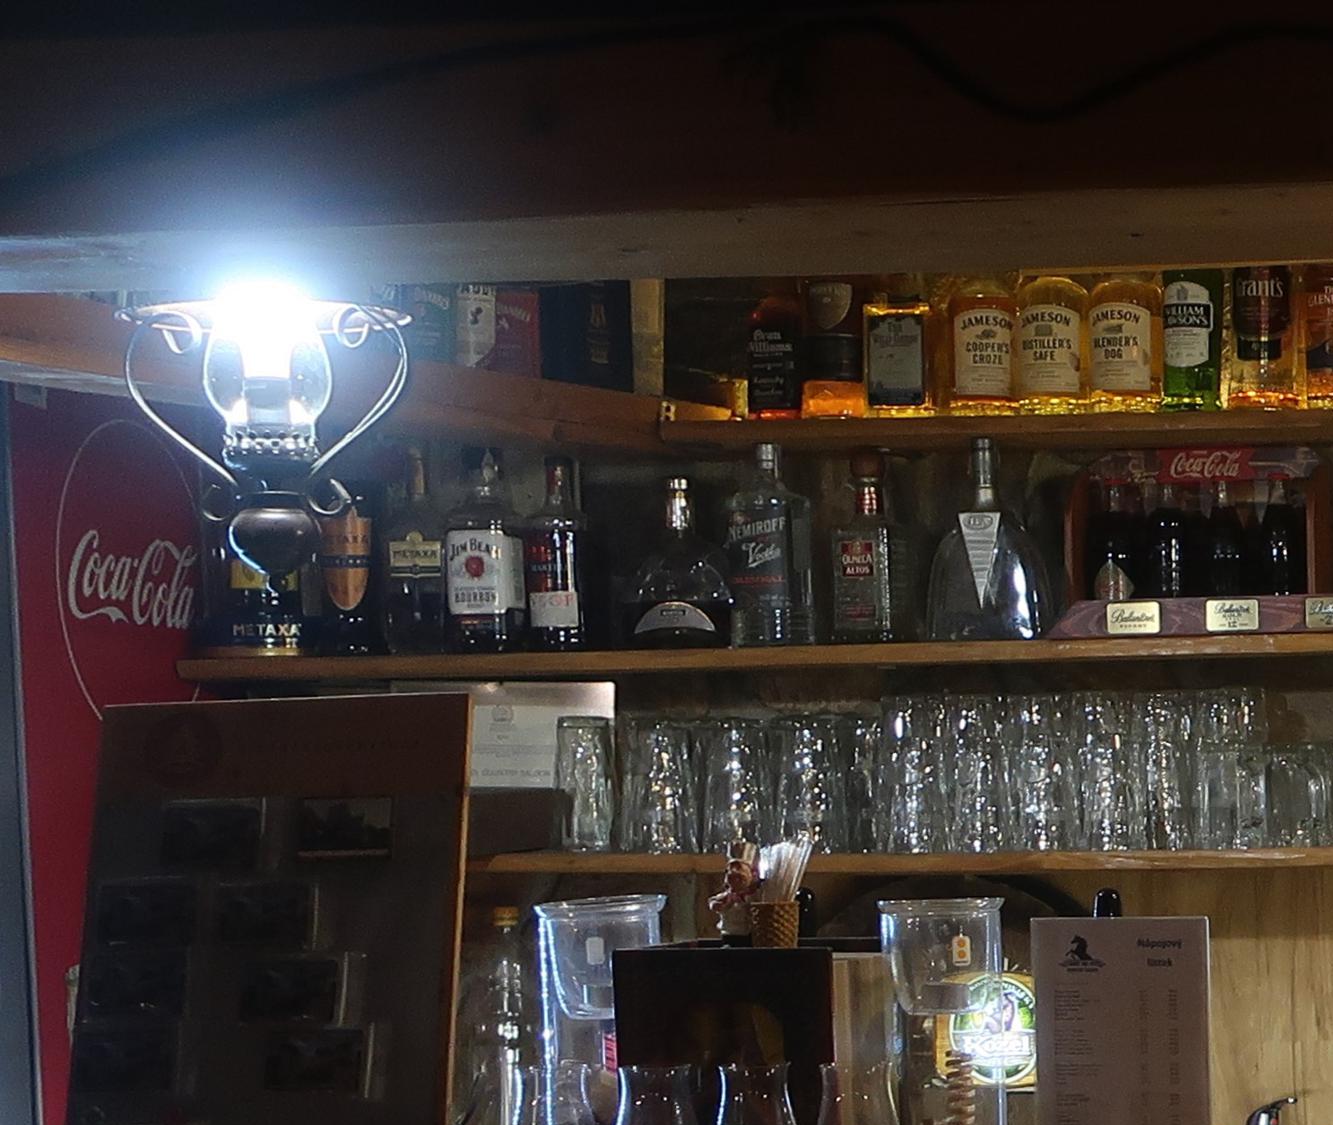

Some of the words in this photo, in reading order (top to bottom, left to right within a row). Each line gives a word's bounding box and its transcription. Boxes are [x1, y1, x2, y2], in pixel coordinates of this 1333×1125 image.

[960, 315, 1013, 331] JAMESON
[966, 340, 1009, 353] COOPER'S
[1033, 349, 1056, 361] SAFE
[1170, 451, 1241, 478] Coca-Cola
[449, 541, 468, 562] JIM
[845, 566, 870, 575] ALTOS
[68, 529, 197, 630] Coca-Cola
[232, 622, 302, 637] METAXA
